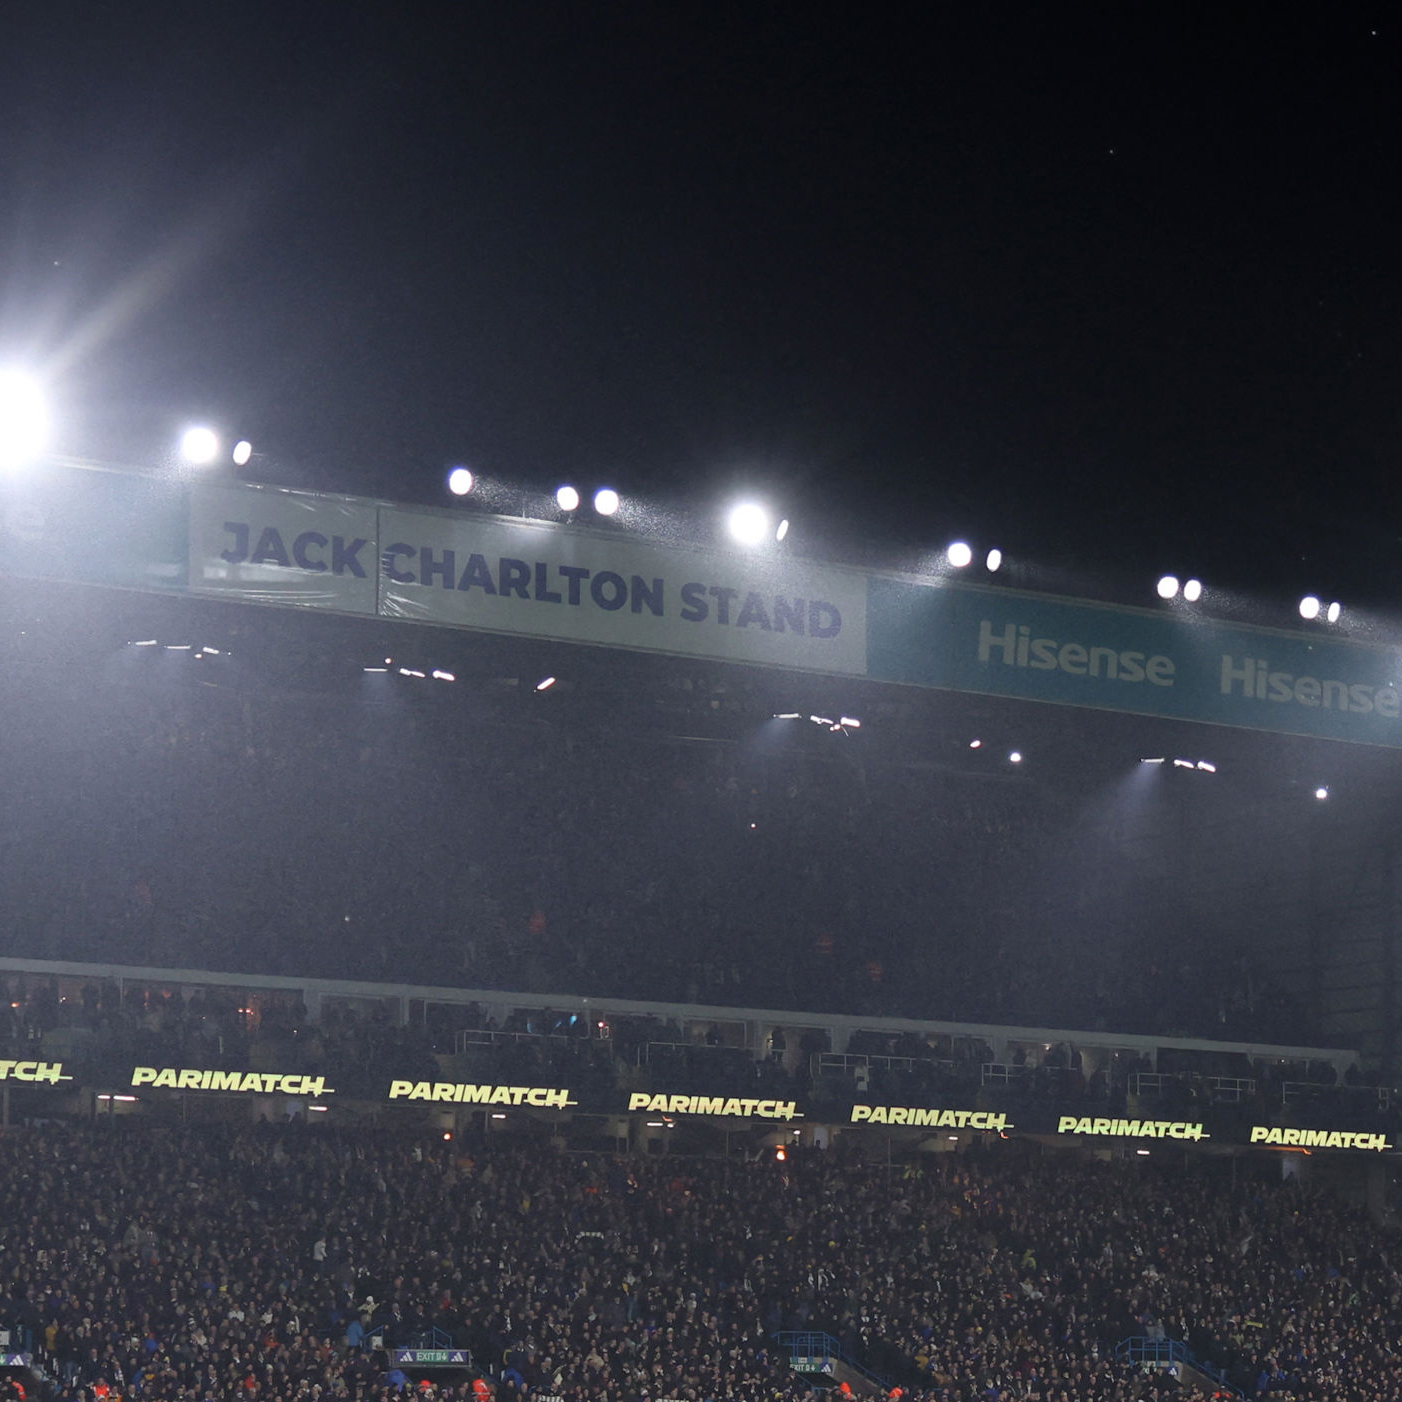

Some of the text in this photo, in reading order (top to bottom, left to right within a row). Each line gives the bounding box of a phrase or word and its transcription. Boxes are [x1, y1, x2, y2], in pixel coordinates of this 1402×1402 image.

[220, 522, 842, 639] JACK CHARLTON STAND
[978, 619, 1175, 687] Hisense
[1220, 653, 1400, 718] Hisense
[131, 1067, 335, 1098] PARIMATCH
[388, 1080, 578, 1110] PARIMATCH
[628, 1092, 804, 1121] PARIMATCH
[851, 1105, 1015, 1131] PARIMATCH
[1058, 1116, 1210, 1142] PARIMATCH
[1250, 1126, 1393, 1152] PARIMATCH
[416, 1352, 435, 1361] EXIT
